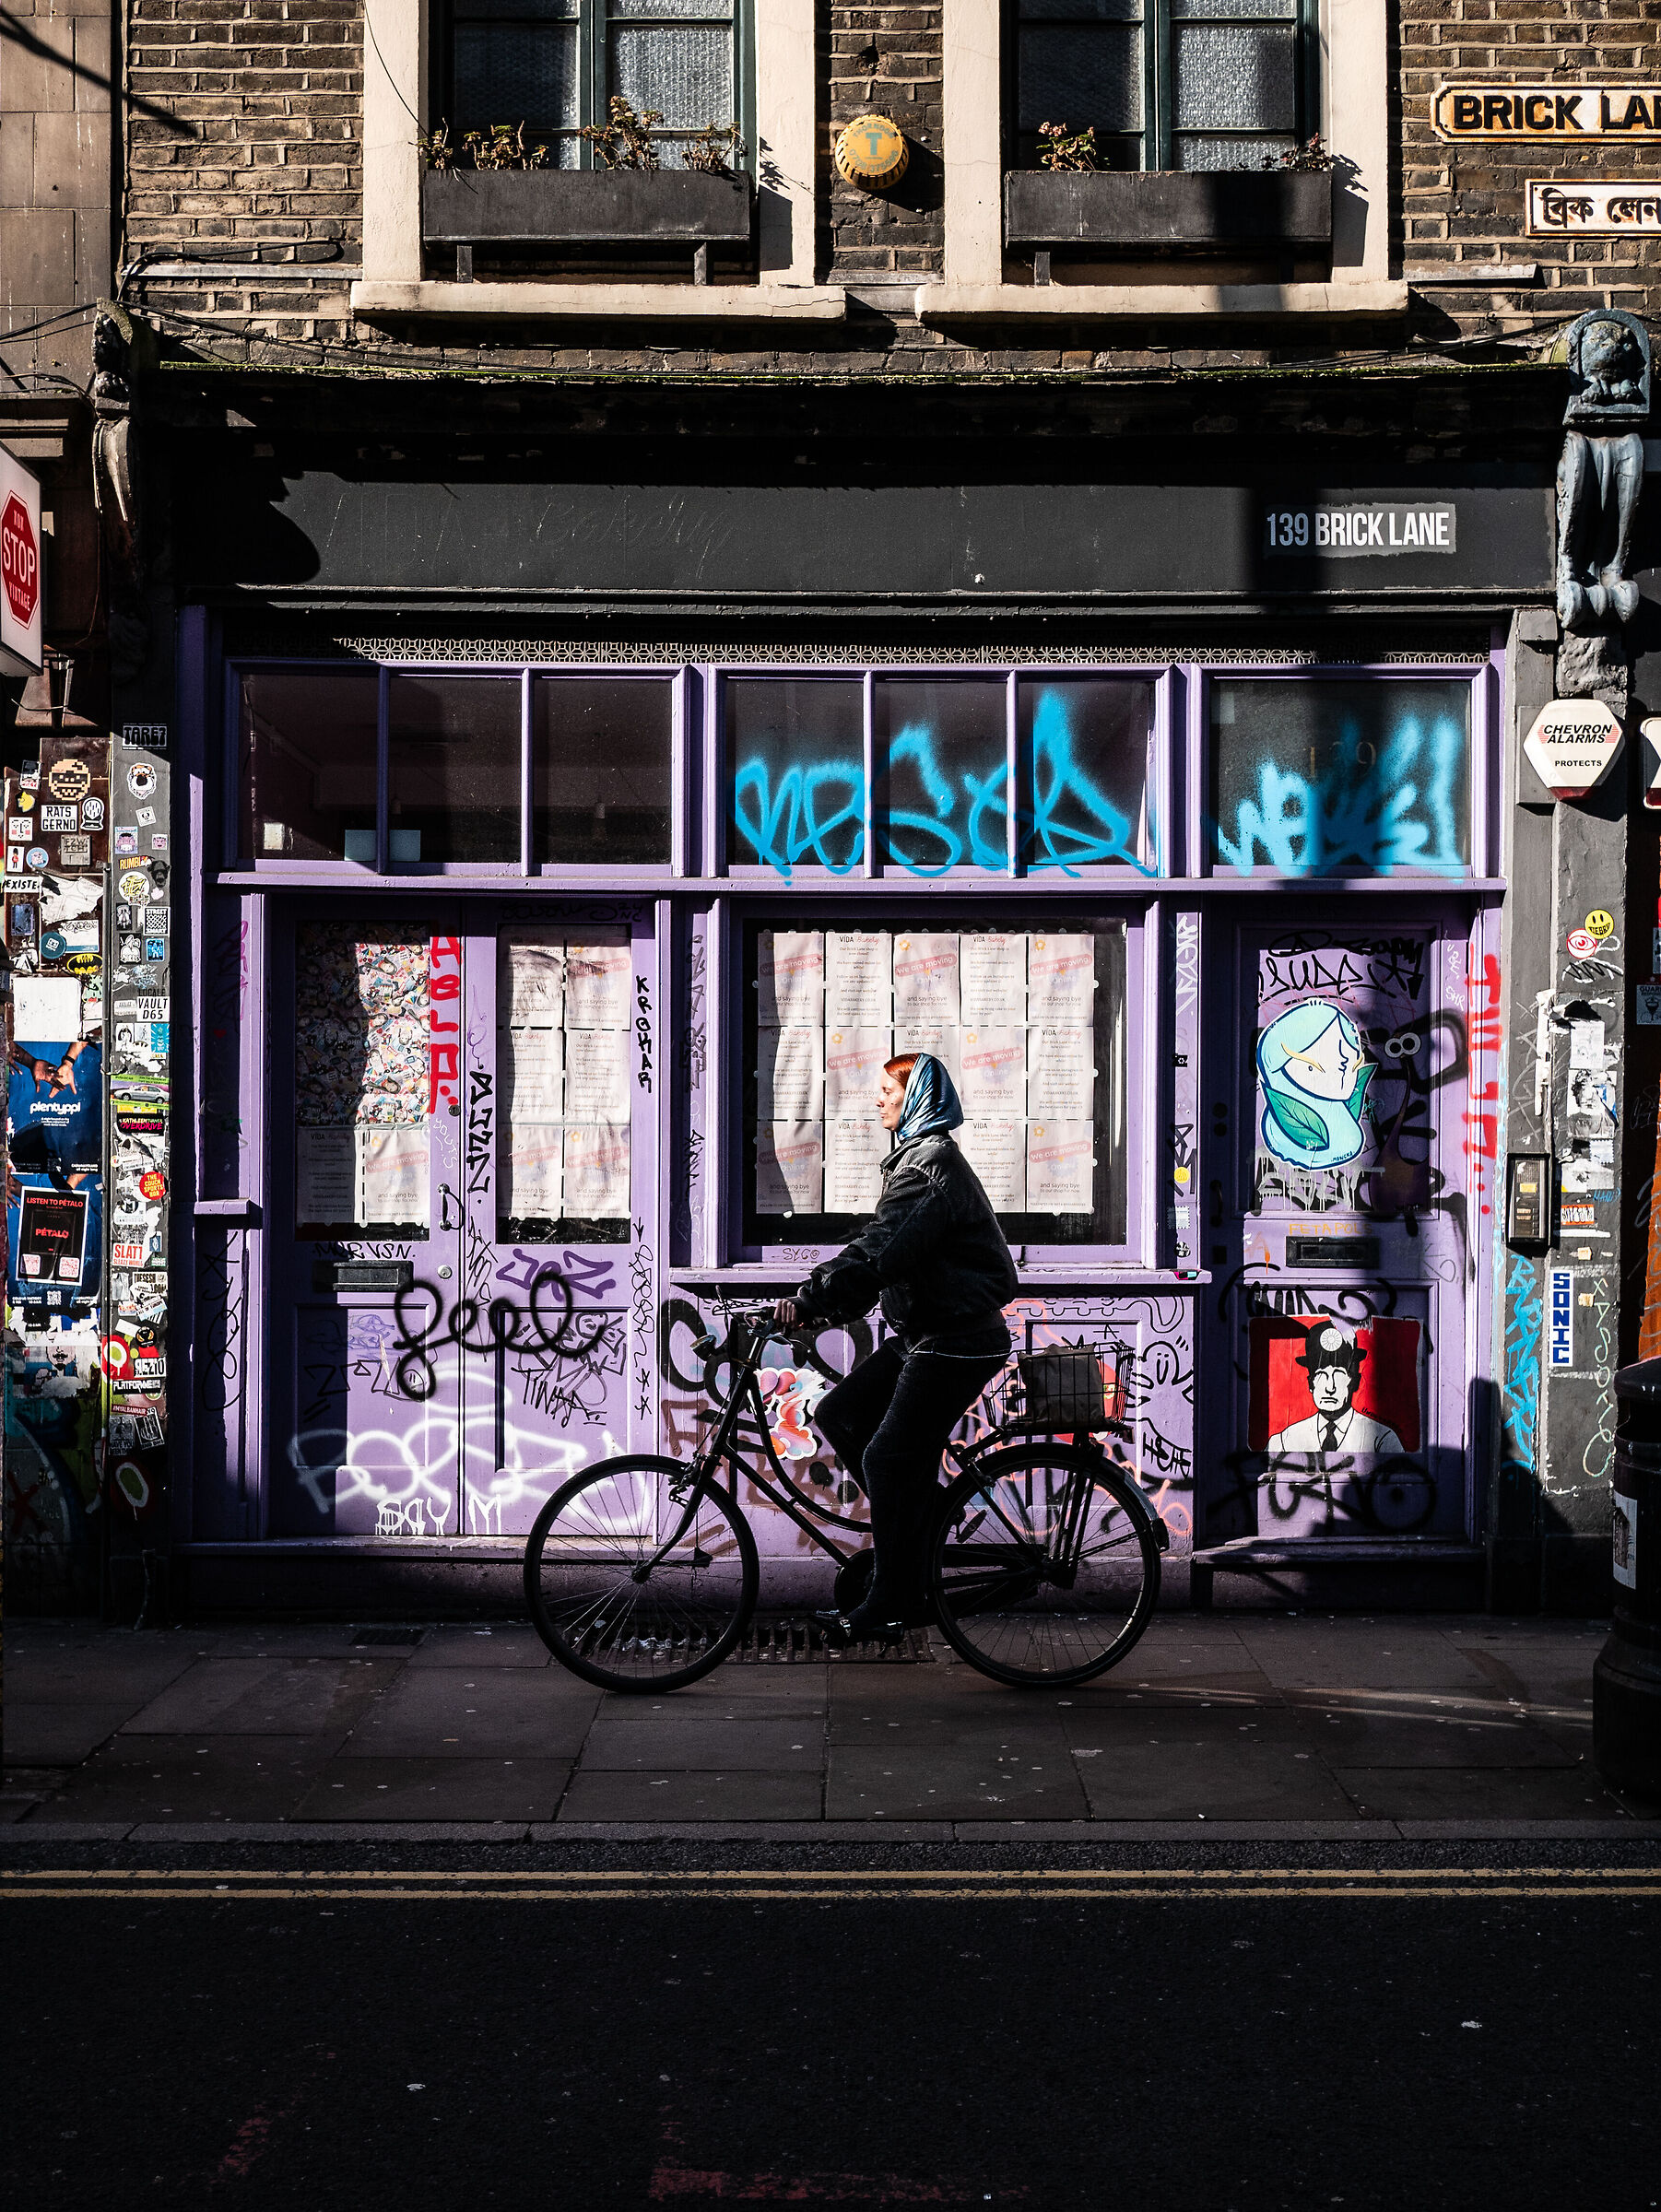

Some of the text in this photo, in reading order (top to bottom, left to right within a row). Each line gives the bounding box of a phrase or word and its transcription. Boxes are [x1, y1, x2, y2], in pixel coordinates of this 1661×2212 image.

[1454, 95, 1584, 129] BRICK
[1266, 512, 1449, 546] 139 BRICK LANE
[4, 526, 35, 586] STOP
[1544, 724, 1612, 735] CHEVRON
[1547, 734, 1606, 743] ALARMS
[46, 806, 72, 818] RATS
[925, 957, 953, 968] moving
[1061, 958, 1089, 968] moving
[138, 998, 168, 1009] VAULT
[993, 1051, 1020, 1062] moving
[120, 1123, 163, 1131] OVERDRIVE
[790, 1145, 818, 1156] moving
[59, 1198, 84, 1207] PÉTALO
[35, 1228, 69, 1239] PÉTALO
[1553, 1272, 1571, 1364] SONIC
